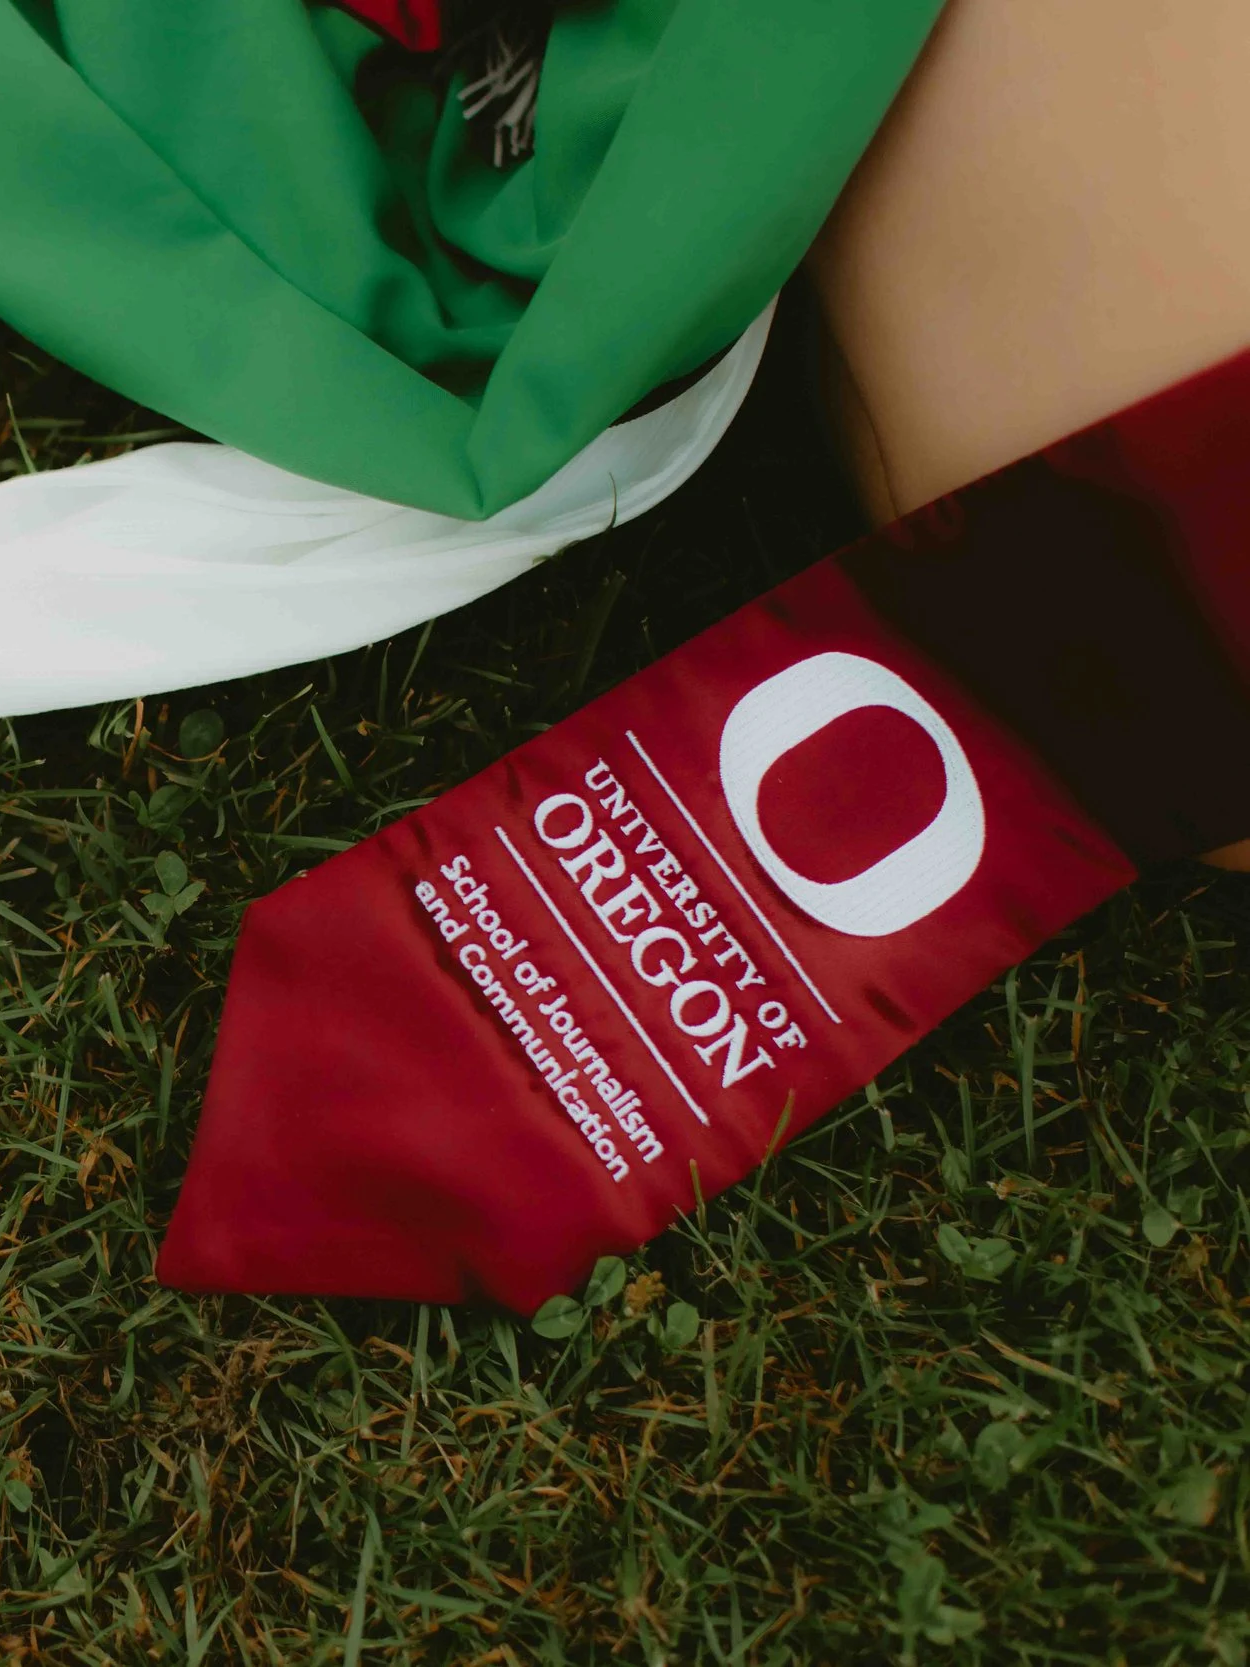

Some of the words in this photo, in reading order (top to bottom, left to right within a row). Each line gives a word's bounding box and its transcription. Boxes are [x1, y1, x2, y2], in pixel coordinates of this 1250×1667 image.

[533, 792, 776, 1089] OREGON
[583, 757, 767, 991] UNIVERSITY
[757, 1000, 808, 1050] OF
[719, 651, 986, 938] O
[415, 880, 470, 943] and
[458, 943, 630, 1183] Communication
[439, 854, 529, 961] School
[513, 961, 557, 996] of
[538, 994, 664, 1164] Journalism
